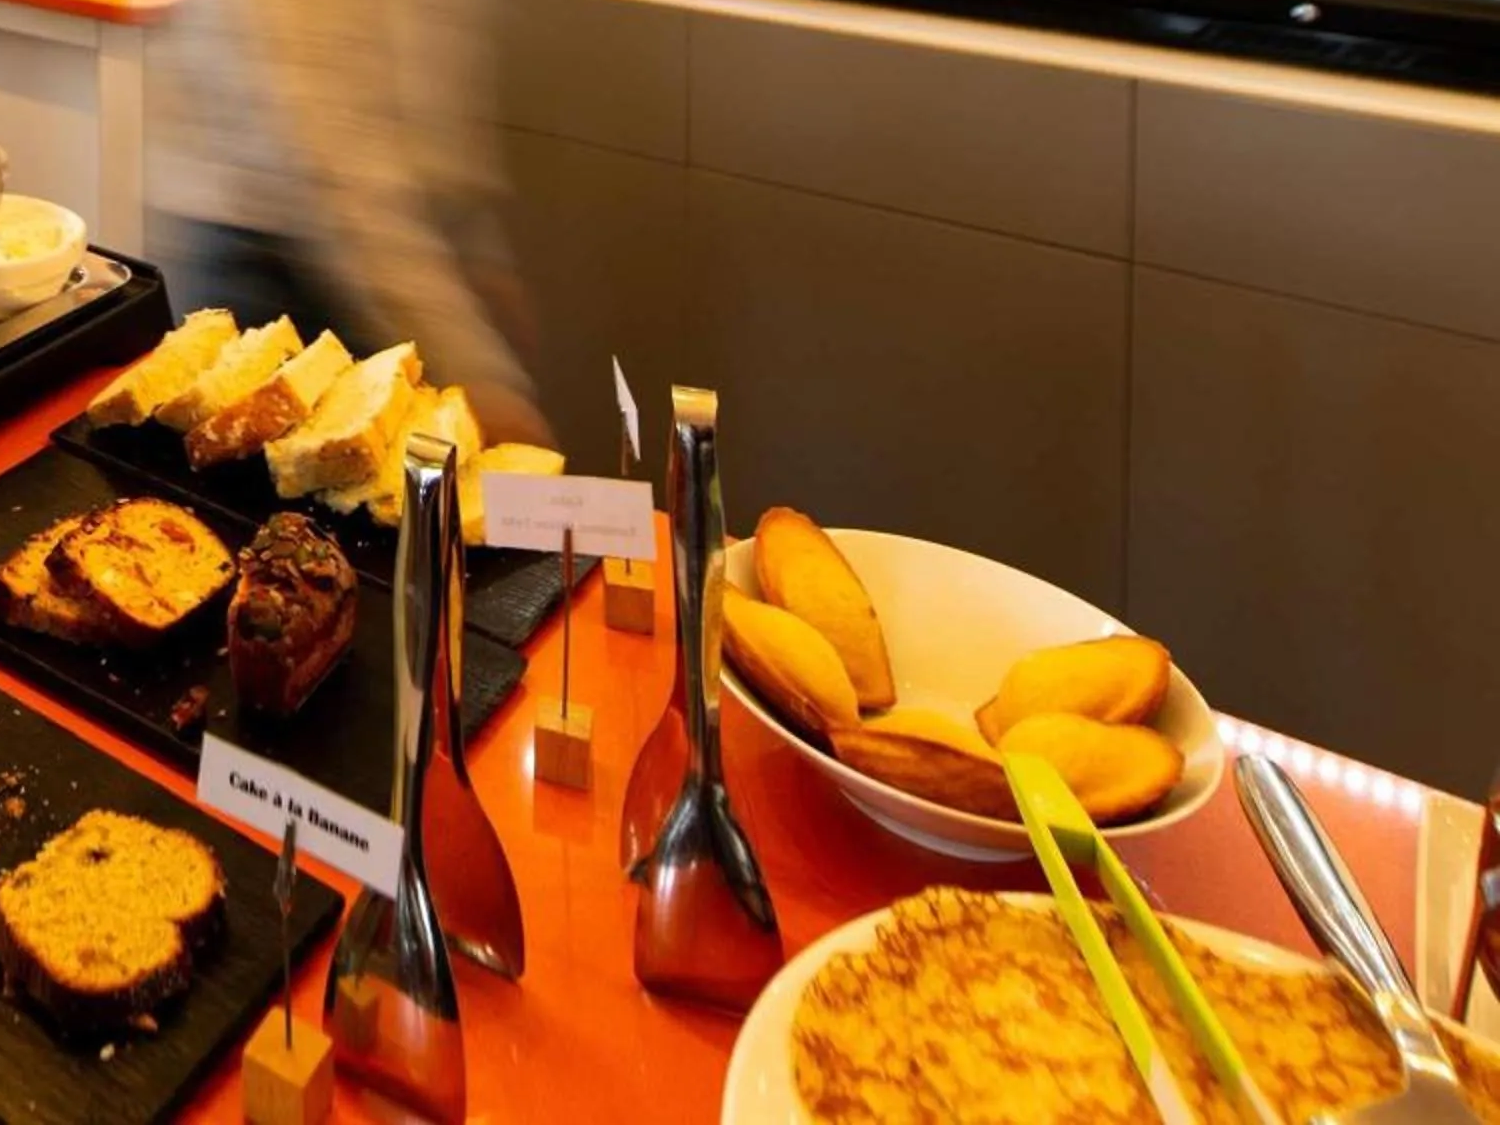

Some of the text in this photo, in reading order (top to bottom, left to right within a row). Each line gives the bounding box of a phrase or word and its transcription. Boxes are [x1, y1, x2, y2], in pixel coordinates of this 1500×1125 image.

[229, 771, 370, 852] Cake à la Banane
